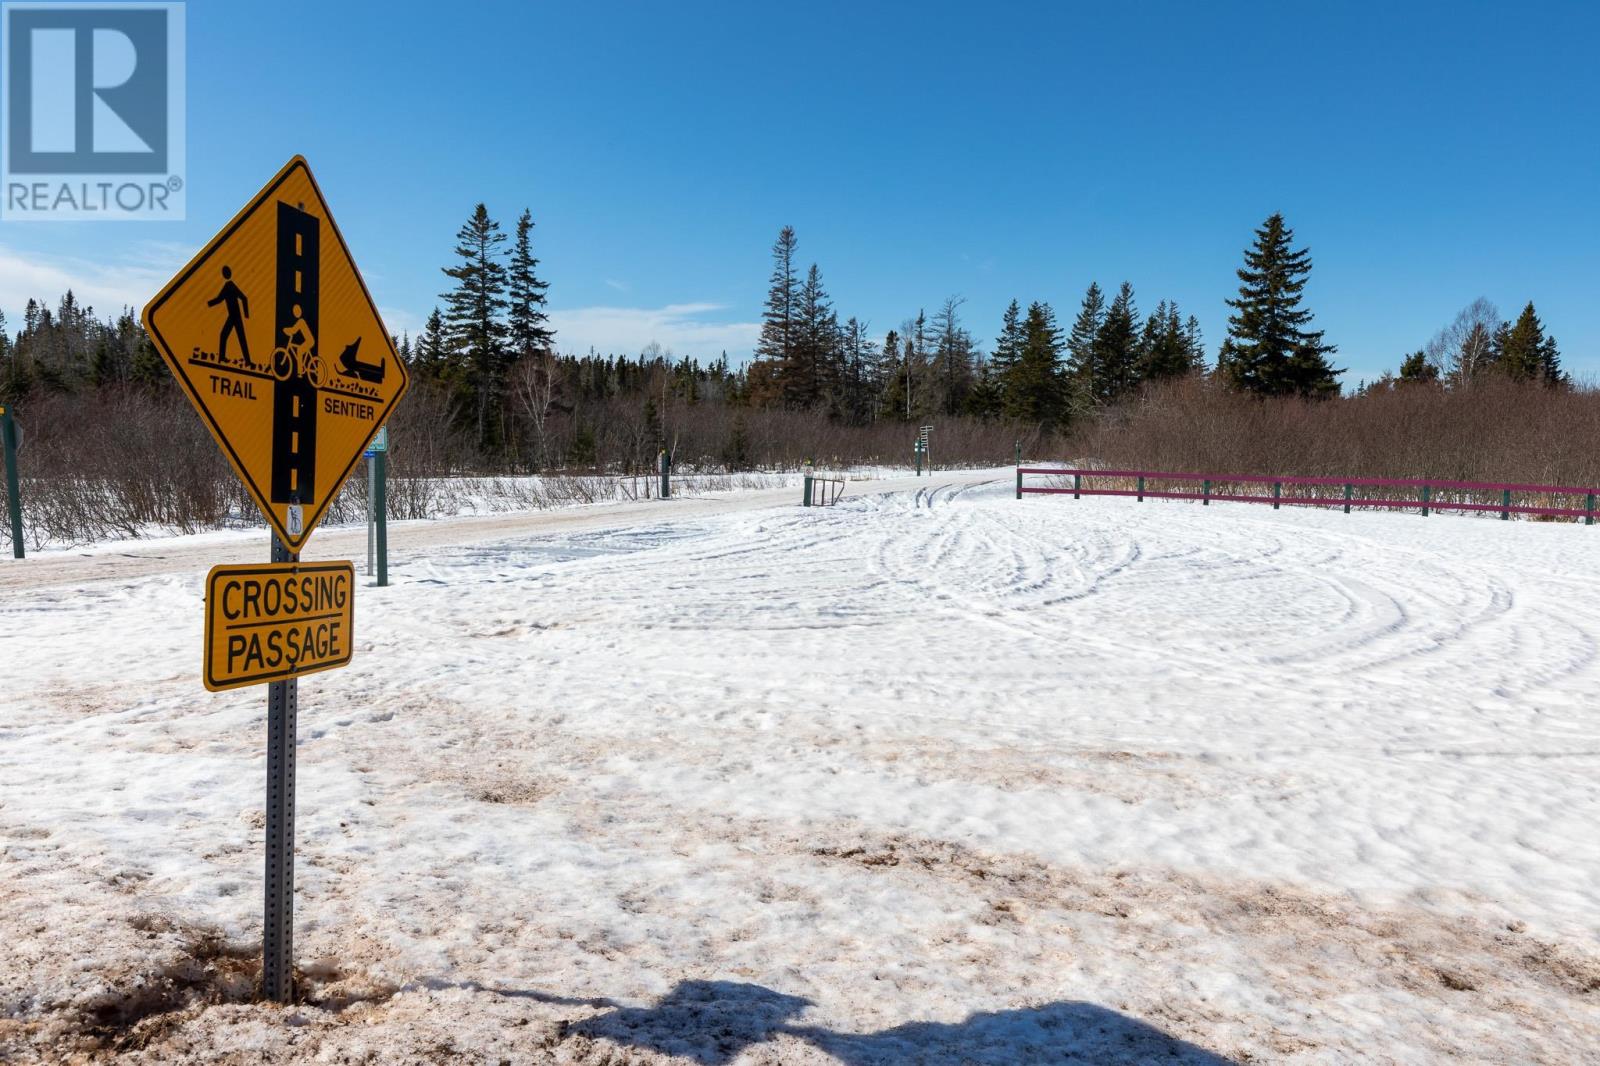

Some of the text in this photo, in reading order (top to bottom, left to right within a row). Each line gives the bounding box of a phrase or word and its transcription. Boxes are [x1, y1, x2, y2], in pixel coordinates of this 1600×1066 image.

[209, 375, 257, 400] TRAIL
[324, 398, 374, 421] SENTIER
[222, 575, 346, 620] CROSSING
[227, 622, 340, 674] PASSAGE
